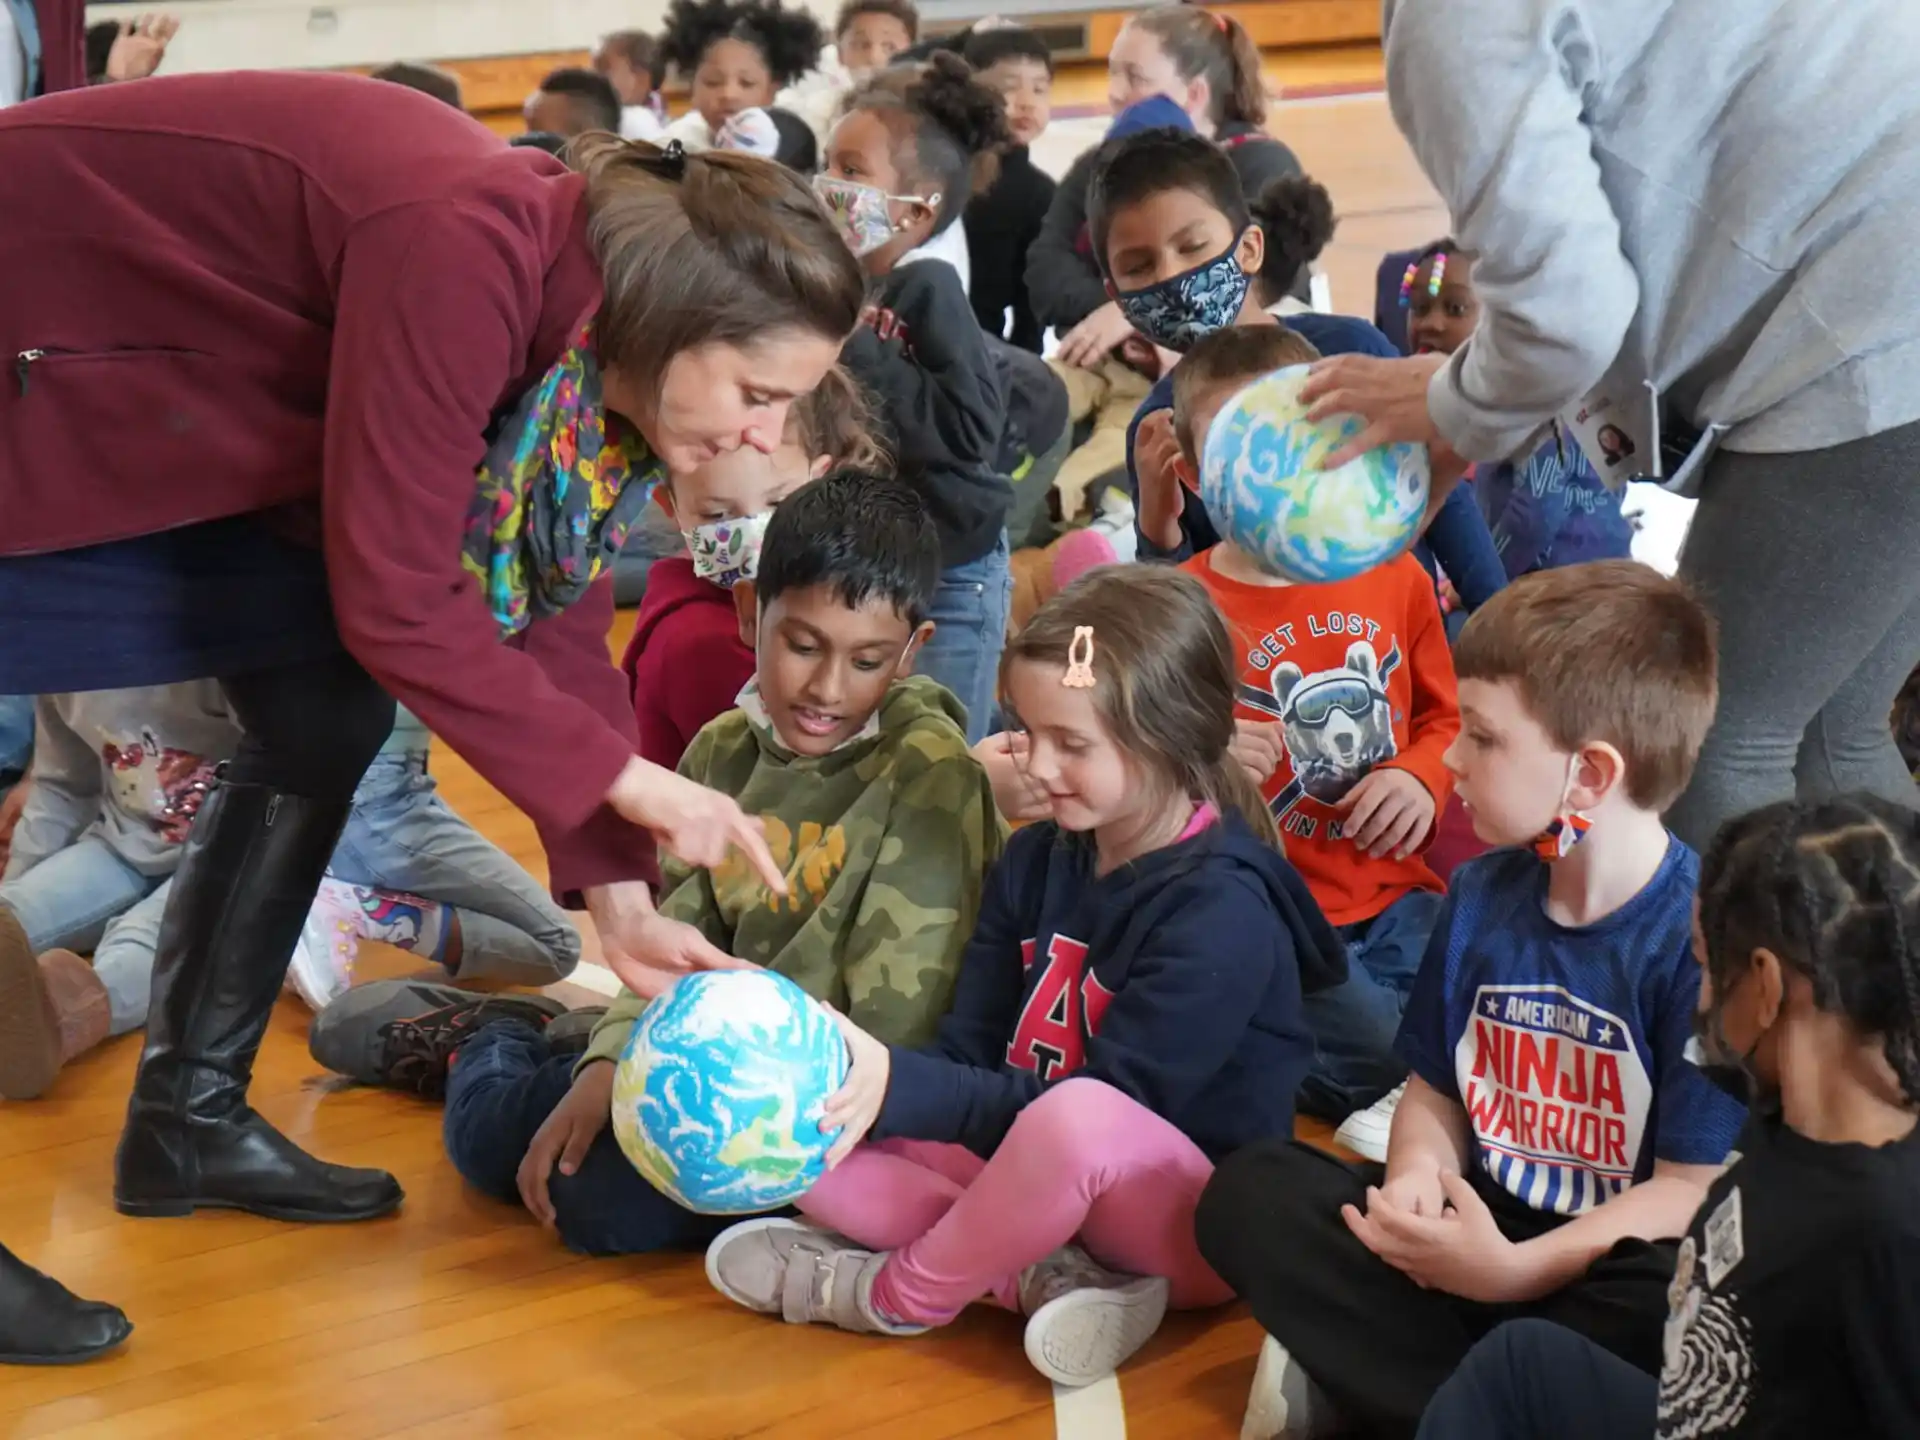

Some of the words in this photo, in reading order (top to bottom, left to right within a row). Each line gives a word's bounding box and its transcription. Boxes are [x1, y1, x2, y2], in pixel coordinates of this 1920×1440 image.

[1248, 622, 1296, 670] GET
[1307, 611, 1381, 642] LOST
[1285, 810, 1317, 838] IN
[1505, 996, 1590, 1040] AMERICAN
[1471, 1018, 1626, 1115] NINJA
[1466, 1081, 1629, 1167] WARRIOR
